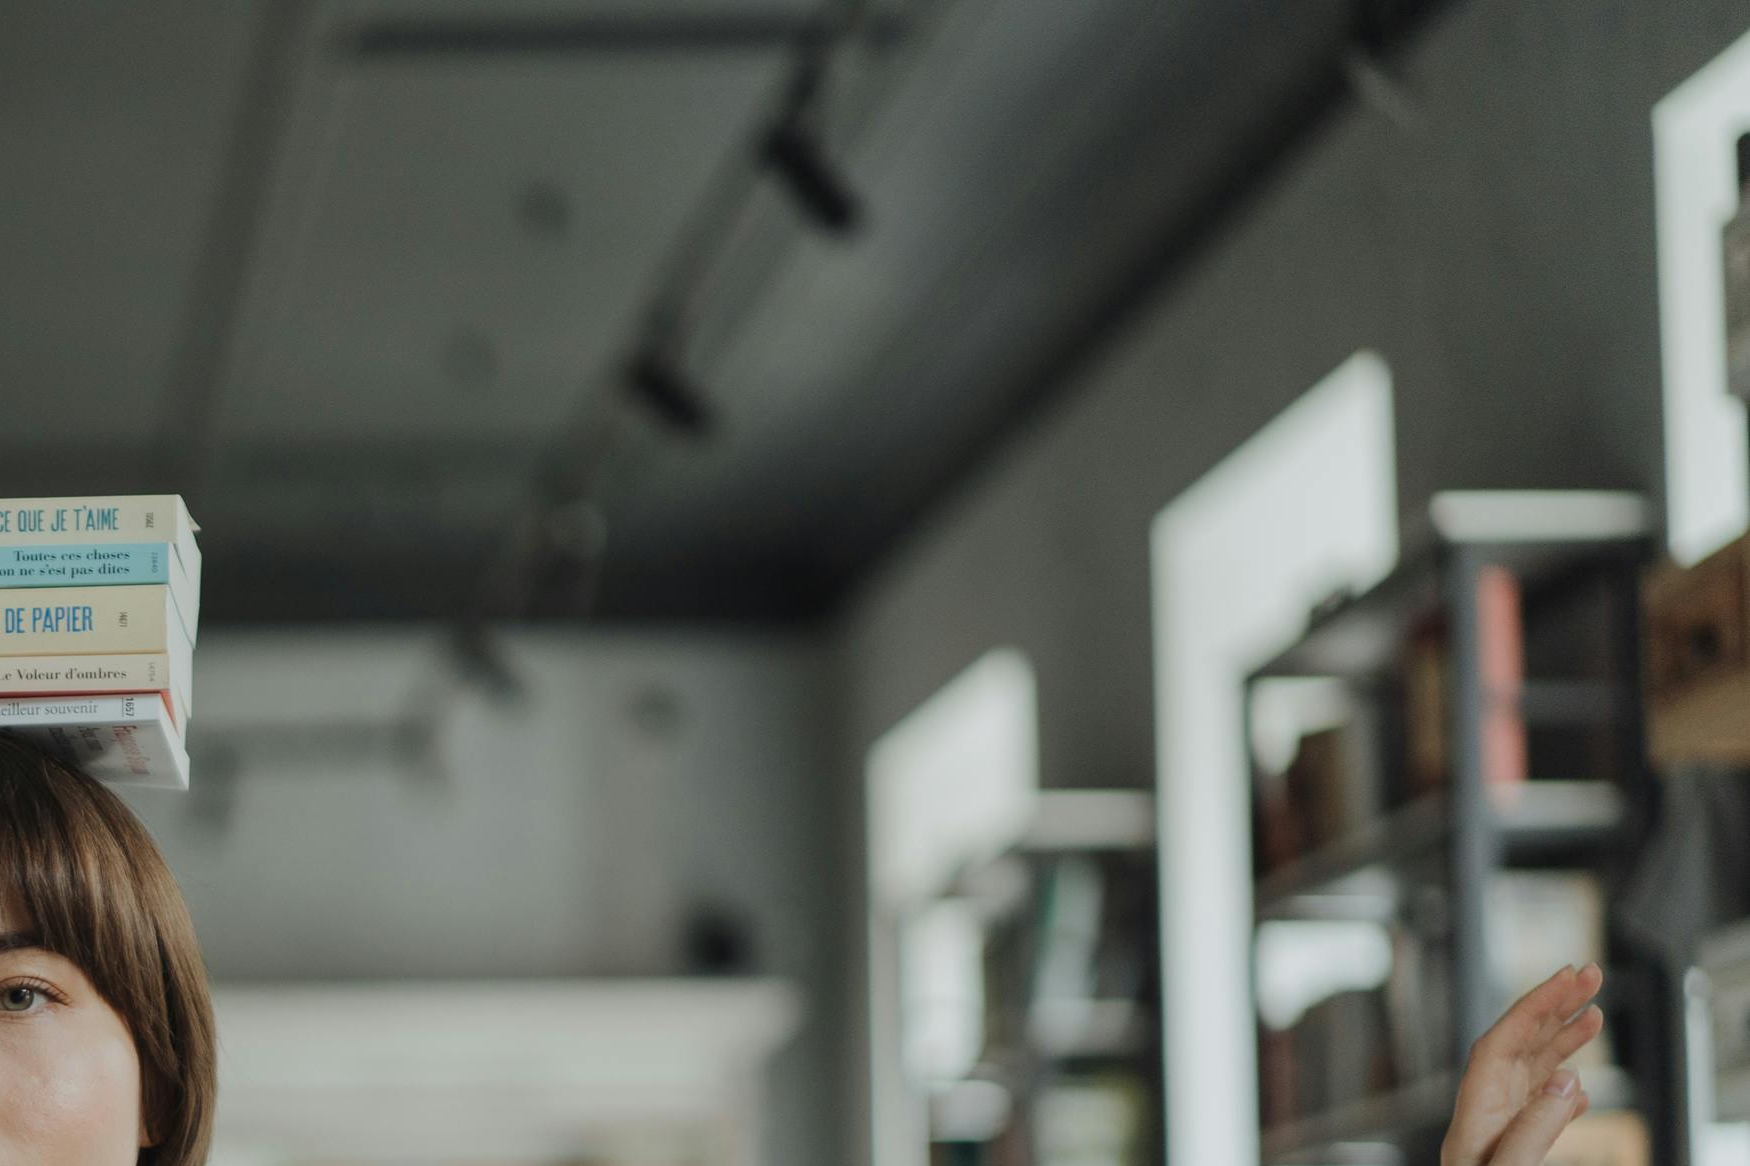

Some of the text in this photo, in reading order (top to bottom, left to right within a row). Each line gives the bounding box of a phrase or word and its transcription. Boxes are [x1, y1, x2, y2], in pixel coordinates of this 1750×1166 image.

[17, 509, 45, 532] QUE
[51, 508, 68, 532] JE
[73, 505, 120, 531] T'AIME
[13, 548, 131, 562] Toutes ces choses
[19, 566, 36, 576] ne
[39, 563, 67, 576] s'est
[70, 565, 94, 579] pas
[97, 561, 130, 575] dites
[5, 607, 26, 633] DE
[32, 605, 94, 633] PAPIER
[17, 668, 60, 680] Voleur
[65, 667, 127, 680] d'ombres
[43, 701, 99, 715] souvenir
[125, 697, 134, 718] 1657
